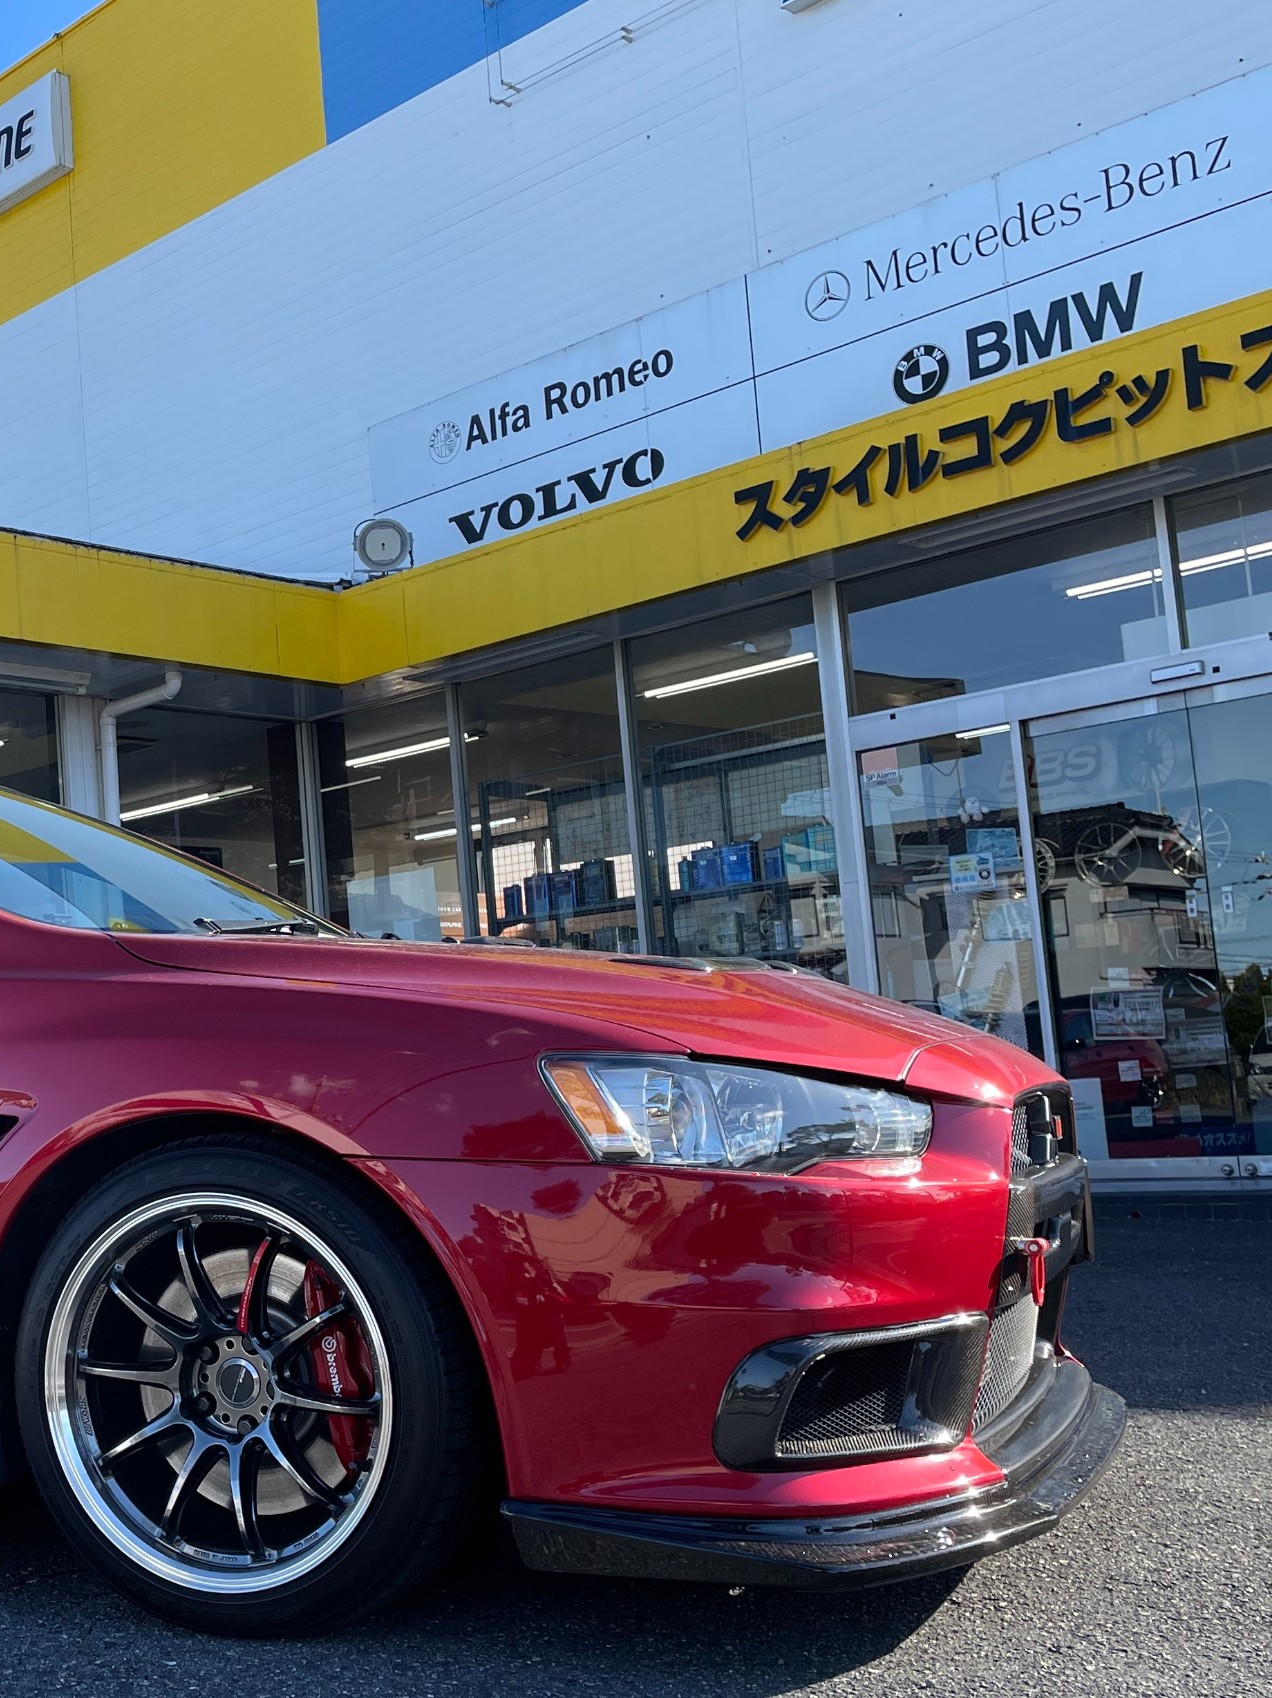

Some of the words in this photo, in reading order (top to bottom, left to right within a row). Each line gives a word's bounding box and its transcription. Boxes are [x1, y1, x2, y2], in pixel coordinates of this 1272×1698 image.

[863, 135, 1232, 301] Mercedes-Benz
[898, 346, 944, 371] BMW
[966, 271, 1143, 381] BMW
[465, 401, 531, 451] Alfa
[543, 349, 674, 421] Romeo
[448, 447, 665, 545] VOLVO
